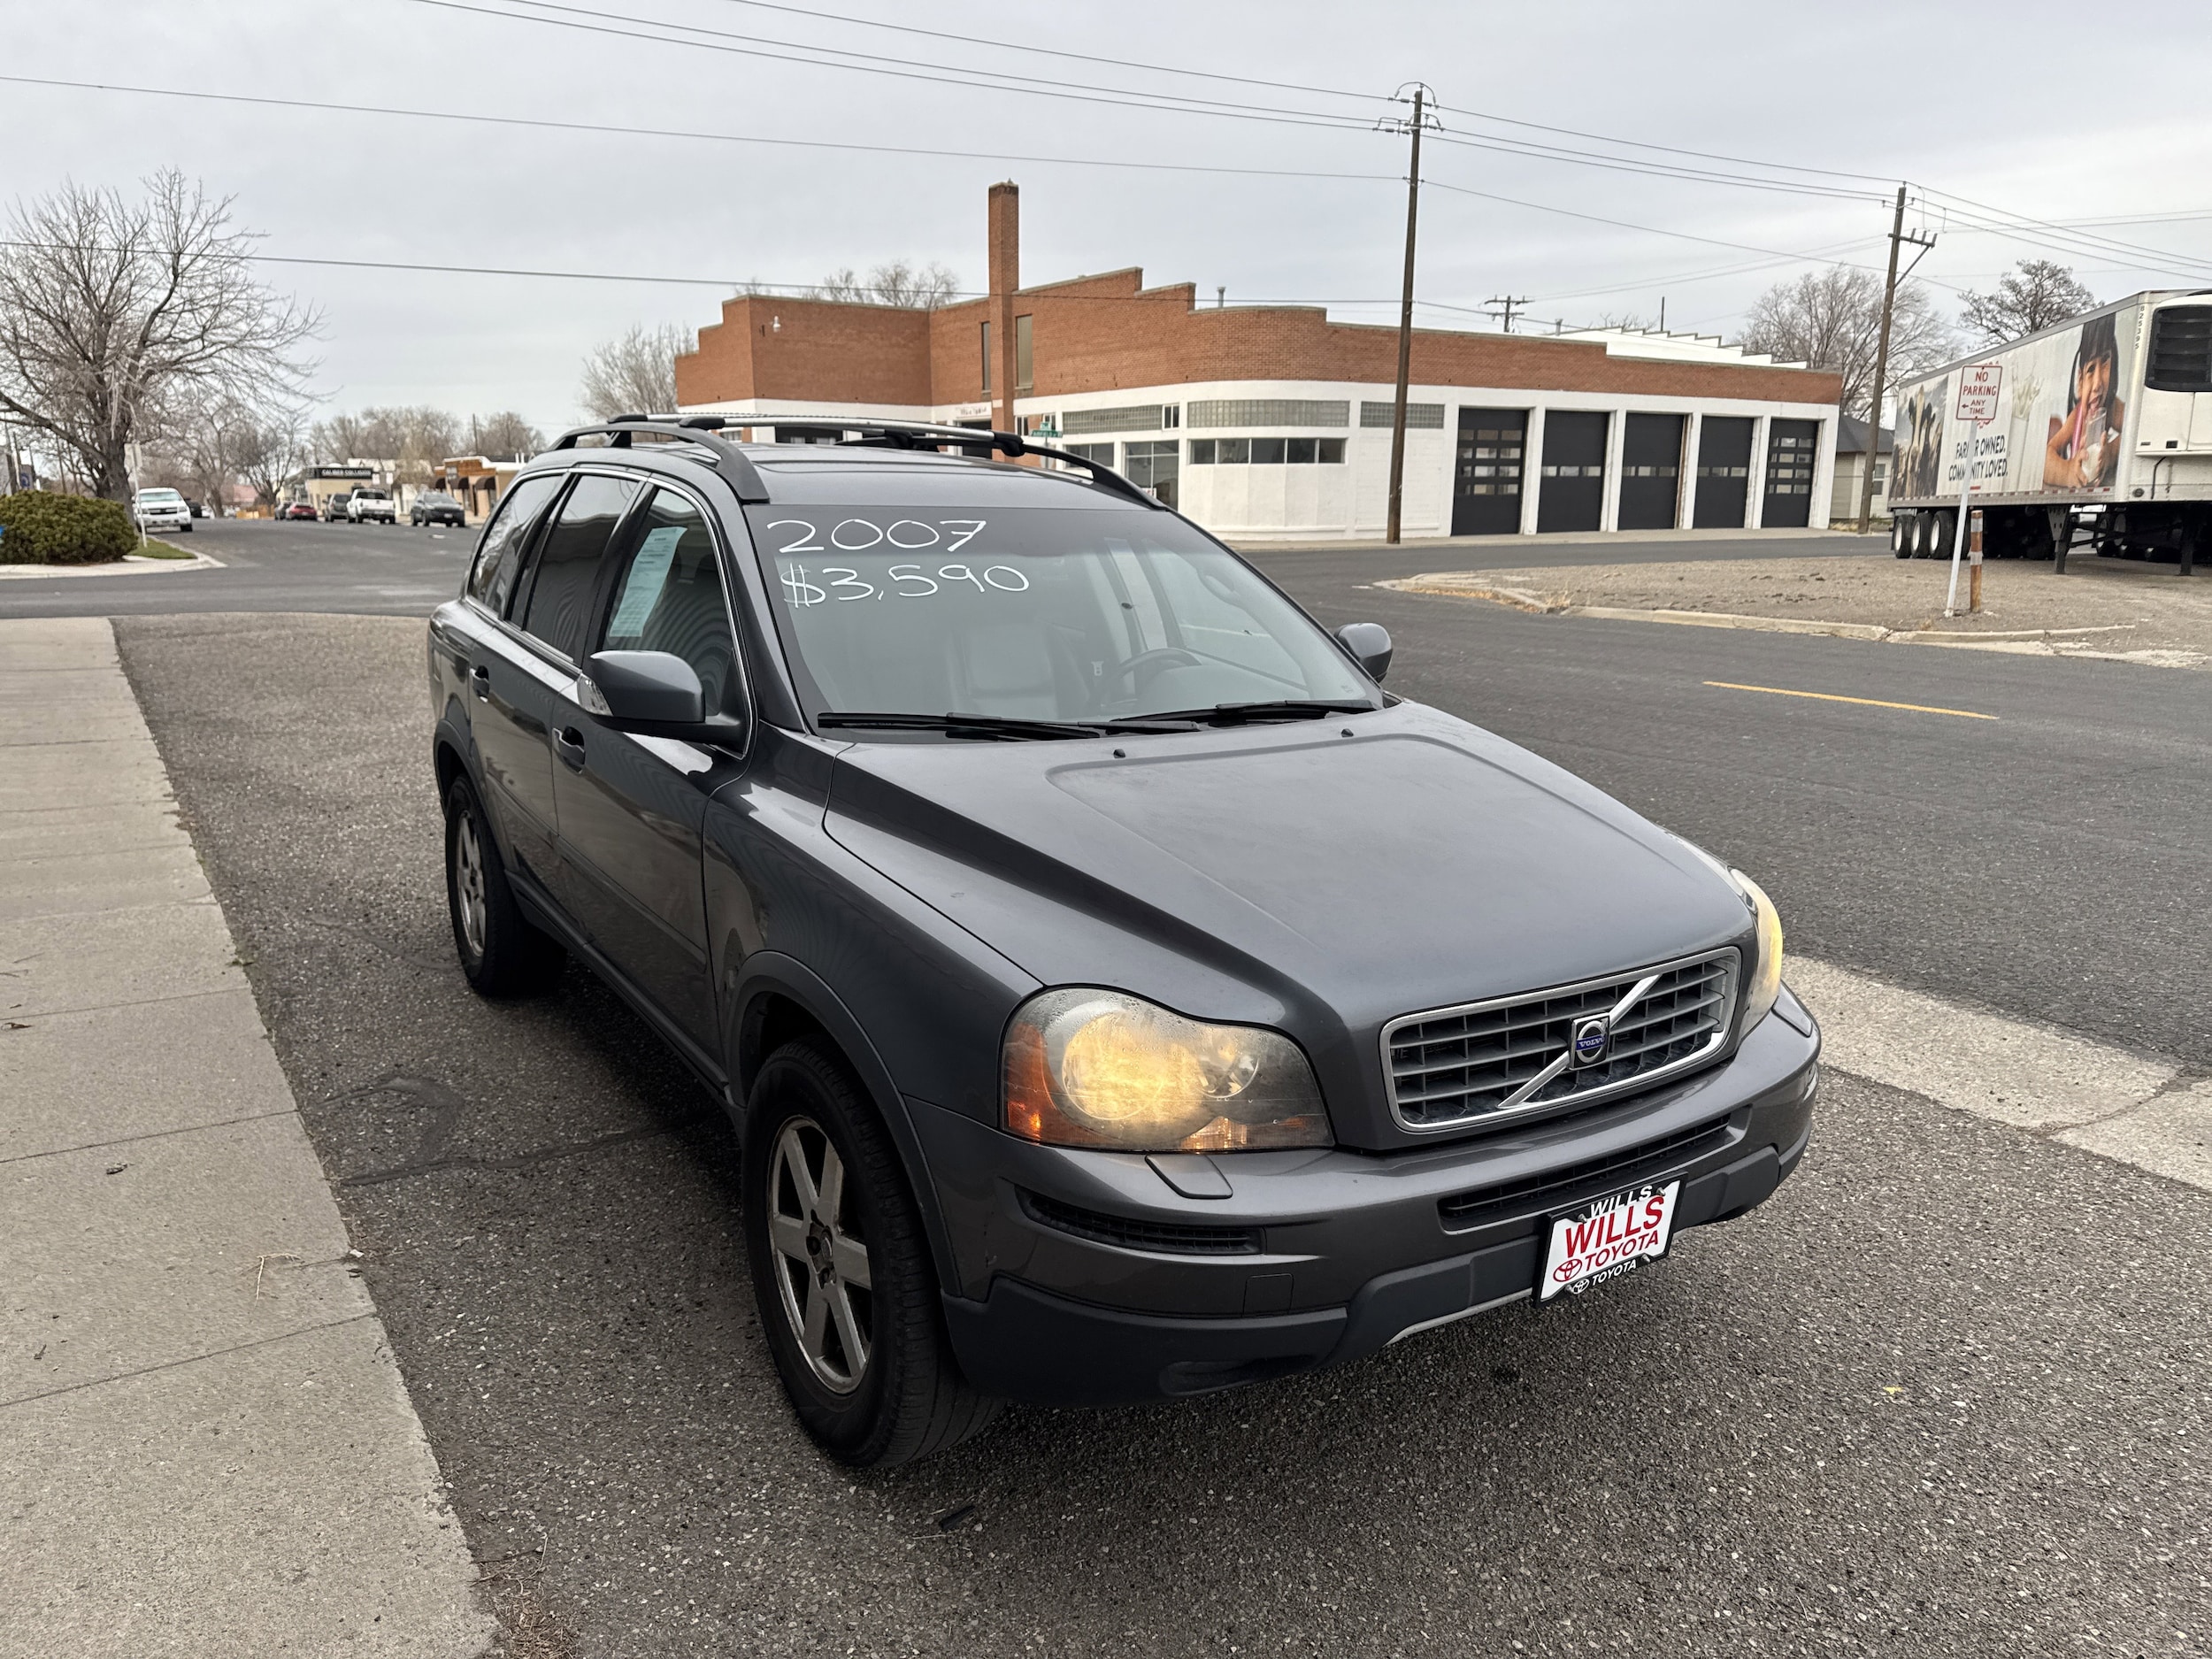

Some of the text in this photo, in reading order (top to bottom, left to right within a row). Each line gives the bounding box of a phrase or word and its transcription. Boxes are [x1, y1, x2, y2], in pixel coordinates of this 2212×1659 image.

[1975, 371, 1989, 382] NO
[1962, 385, 1997, 396] PARKING
[1955, 434, 2006, 459] FARR OWNED.
[1948, 458, 2008, 481] COMMNITY LOVED.
[766, 518, 987, 553] 2007
[780, 562, 1030, 609] $3,590
[1578, 1036, 1605, 1048] VOLVO
[1590, 1185, 1653, 1218] WILLS
[1565, 1195, 1664, 1258] WILLS
[1585, 1230, 1659, 1272] TOYOTA
[1592, 1259, 1637, 1286] TOYOTA
